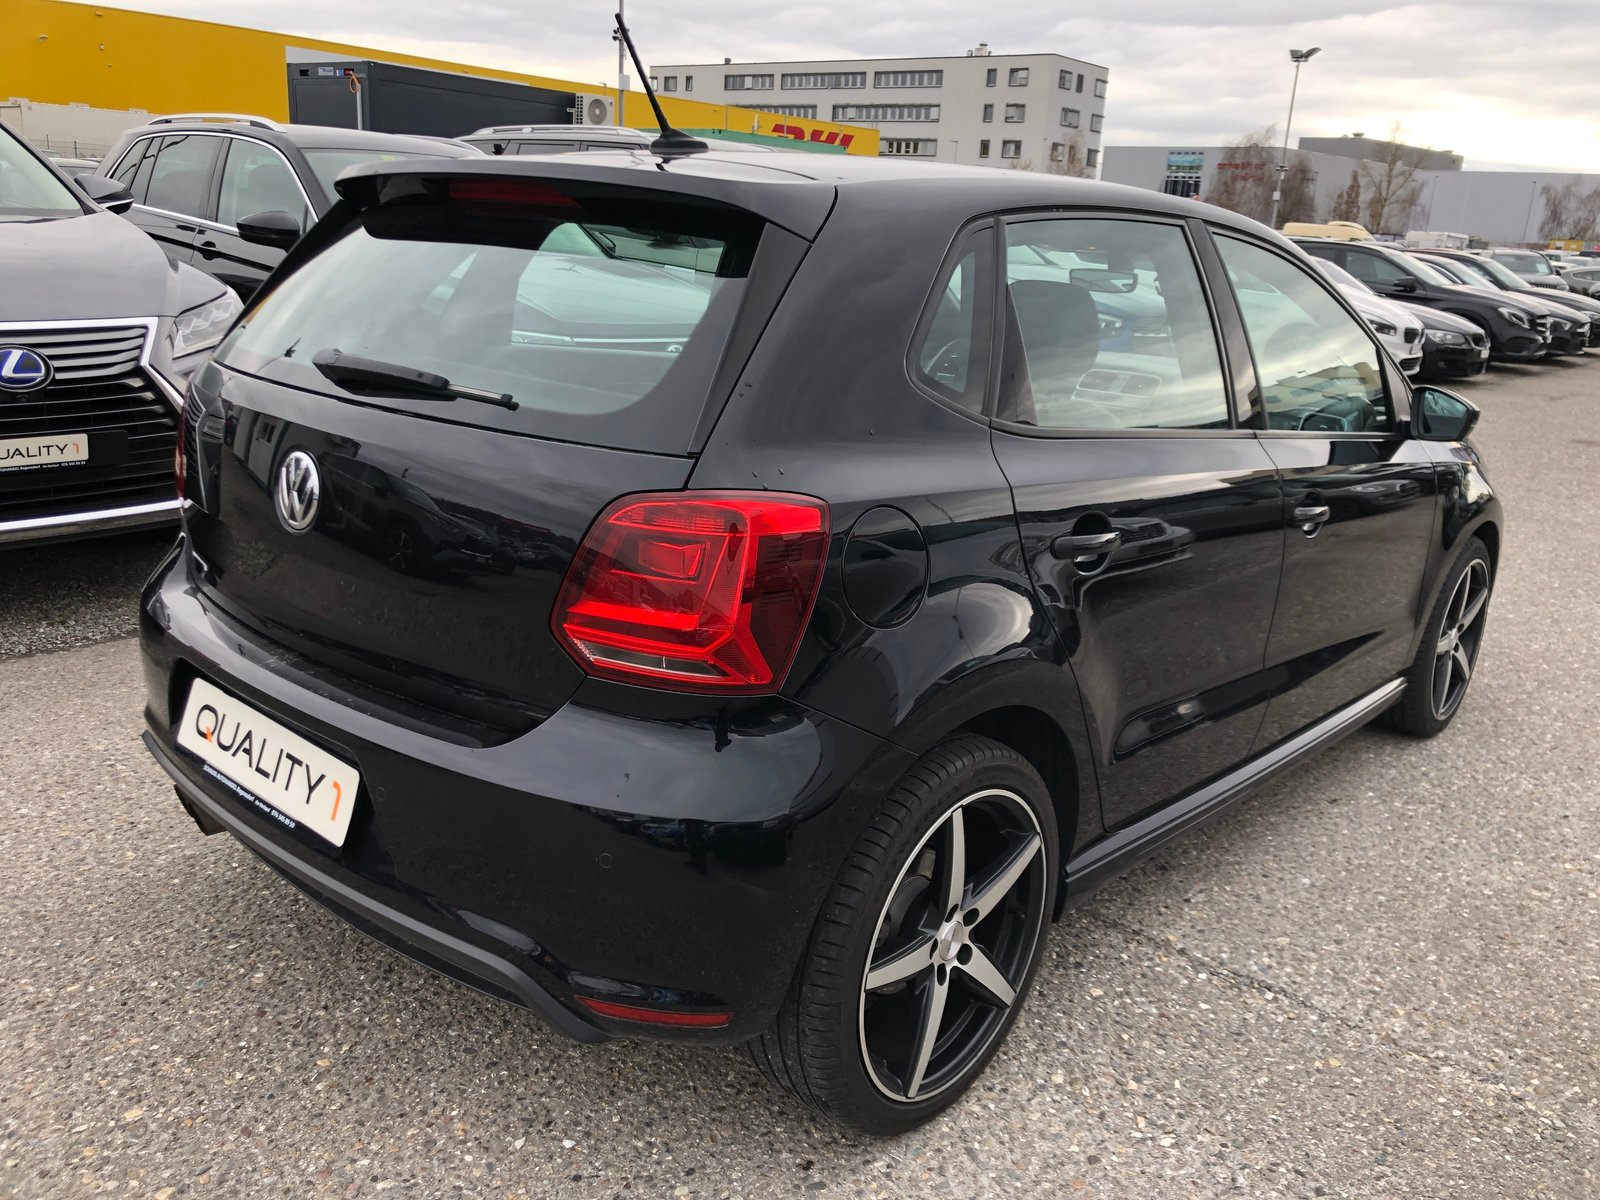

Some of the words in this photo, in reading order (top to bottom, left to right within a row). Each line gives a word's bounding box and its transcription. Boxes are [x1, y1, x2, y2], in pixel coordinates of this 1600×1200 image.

[0, 444, 68, 460] UALITY
[196, 704, 326, 804] QUALITY
[332, 780, 342, 821] 1
